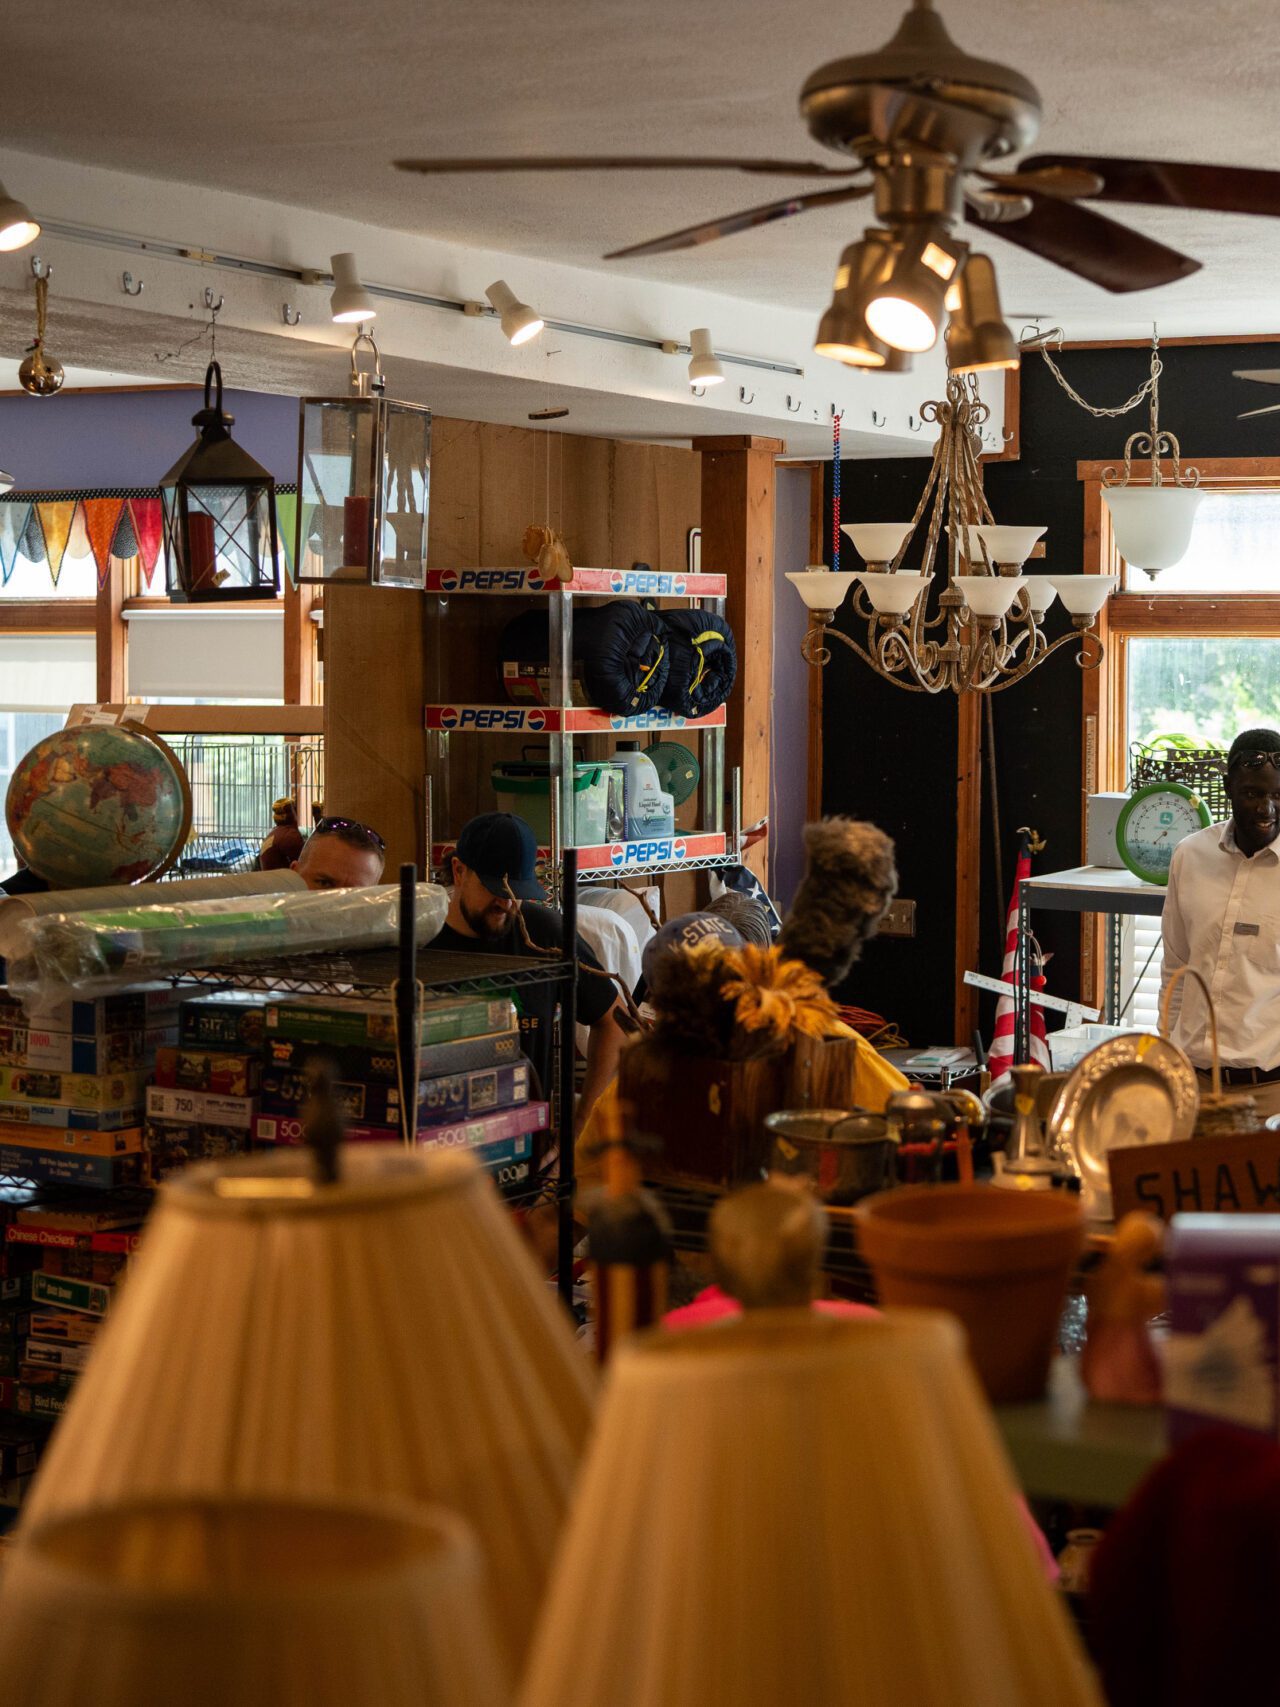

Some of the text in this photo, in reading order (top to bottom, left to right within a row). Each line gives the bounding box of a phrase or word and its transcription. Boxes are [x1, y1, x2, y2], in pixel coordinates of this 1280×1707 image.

[459, 570, 525, 590] PEPSI
[623, 574, 672, 594] PEPSI
[460, 709, 525, 729] PEPSI
[623, 711, 672, 728] PEPSI
[624, 841, 672, 863] PEPSI
[30, 1033, 50, 1047] 1000
[175, 1098, 193, 1113] 750
[8, 1228, 76, 1247] Chinese Checkers
